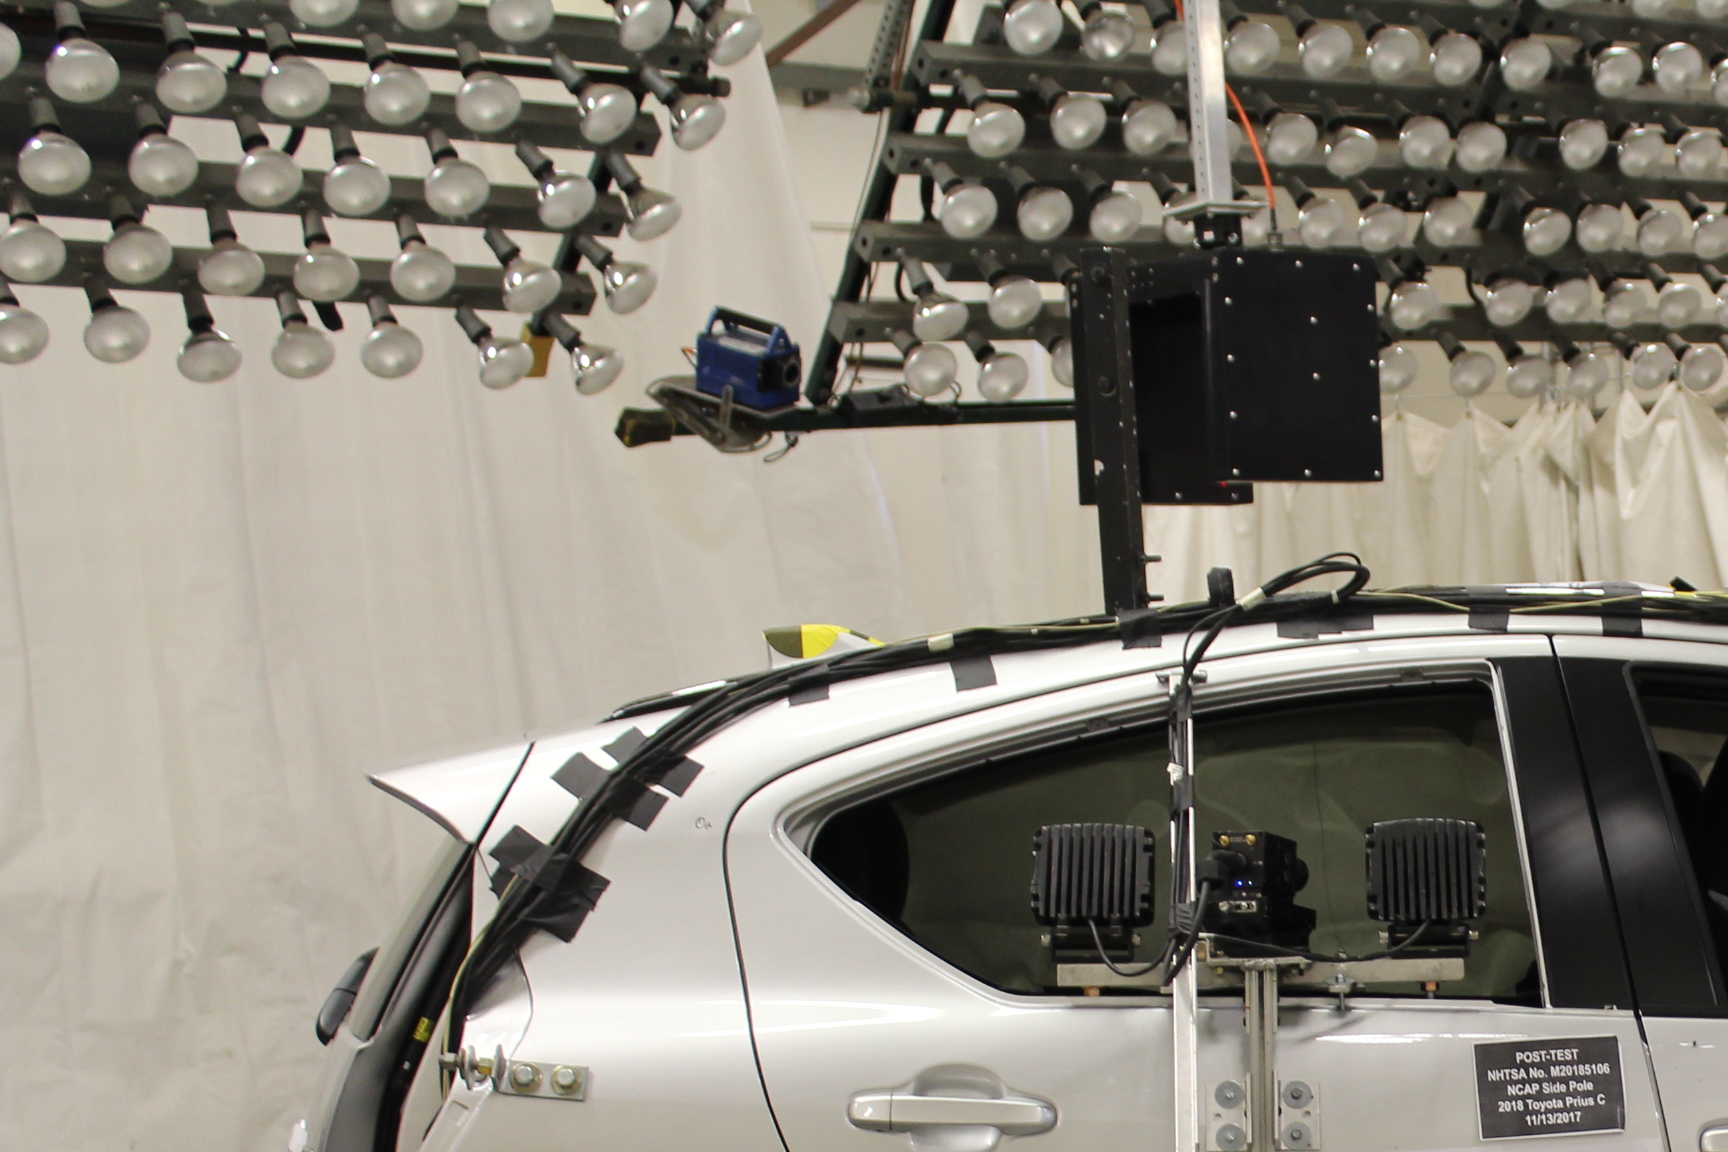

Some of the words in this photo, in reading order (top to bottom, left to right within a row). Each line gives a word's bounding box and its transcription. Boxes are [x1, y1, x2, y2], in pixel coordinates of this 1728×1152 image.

[1516, 1049, 1579, 1063] POST-TEST
[1488, 1069, 1527, 1082] NHTSA
[1529, 1067, 1548, 1079] No.
[1550, 1063, 1610, 1077] M20185106
[1507, 1084, 1539, 1096] NCAP
[1542, 1082, 1566, 1094] Side
[1569, 1080, 1594, 1092] Pole
[1498, 1100, 1524, 1112] 2018
[1526, 1098, 1564, 1112] Toyota
[1566, 1096, 1594, 1108] Prius
[1597, 1094, 1606, 1105] C
[1525, 1111, 1582, 1126] 11/13/2017
